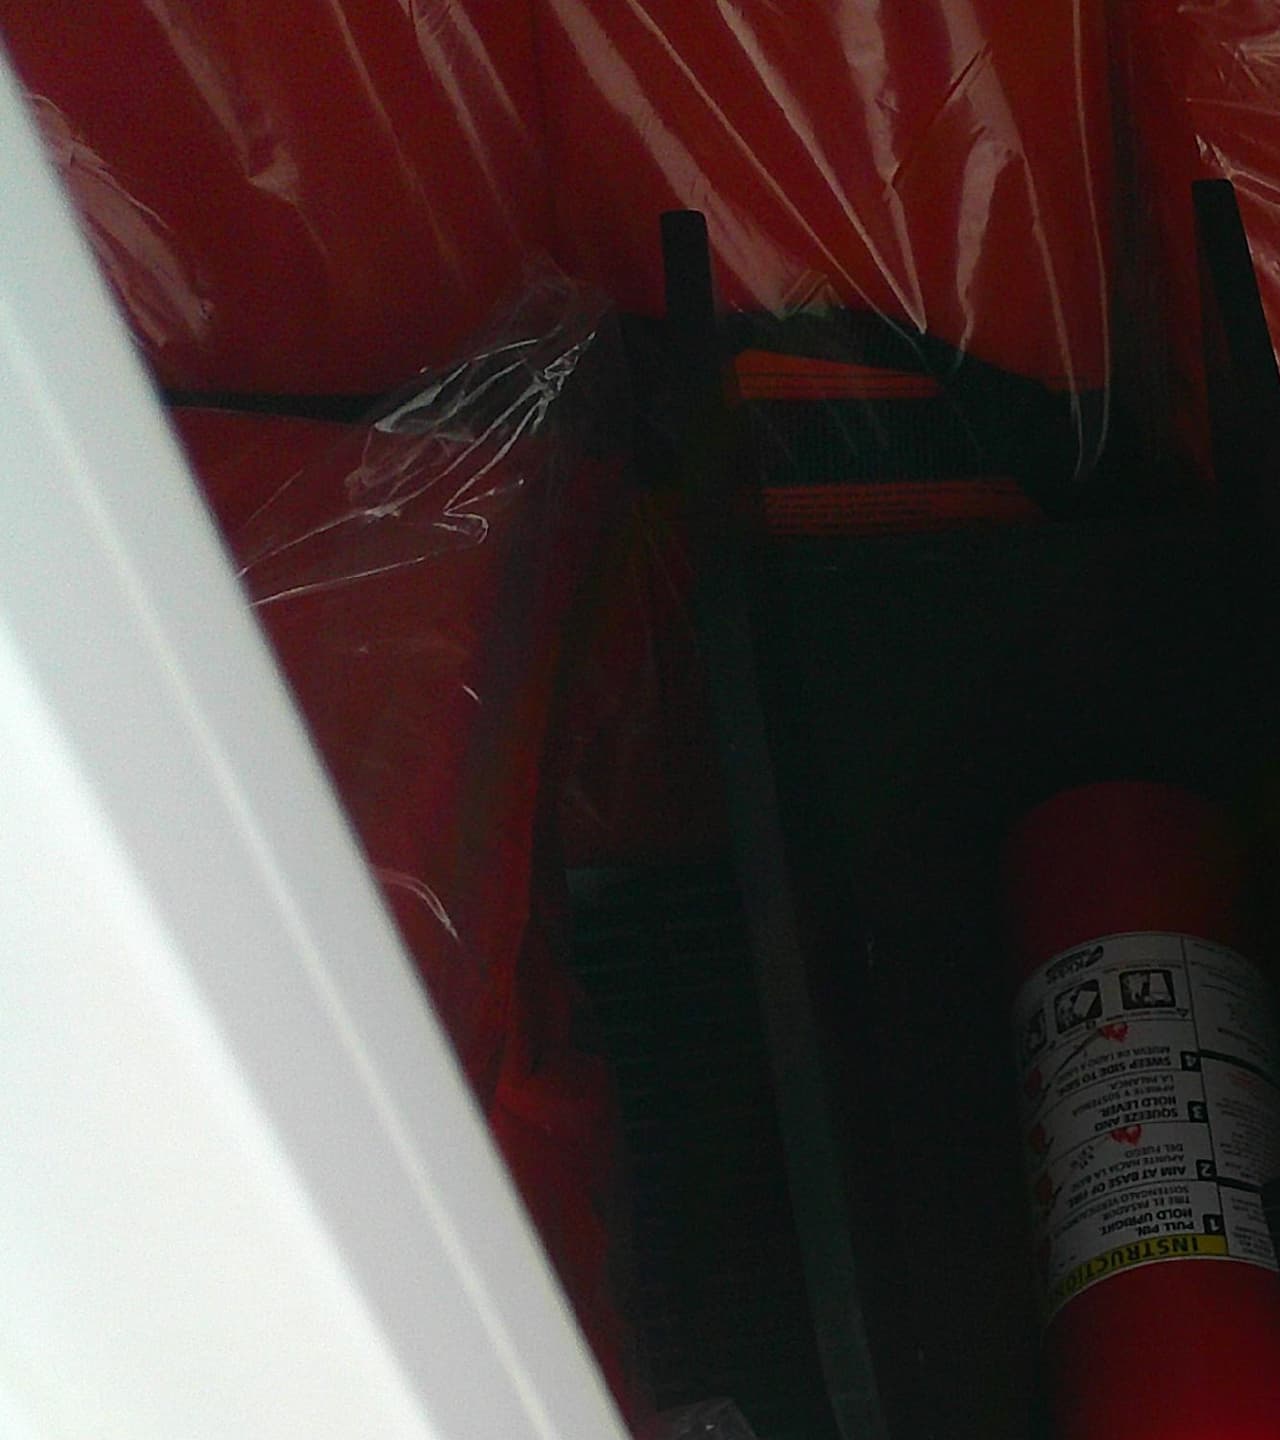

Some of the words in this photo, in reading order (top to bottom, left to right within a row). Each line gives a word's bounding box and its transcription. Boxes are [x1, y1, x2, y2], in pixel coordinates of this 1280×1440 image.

[1130, 1056, 1171, 1069] SWEEP
[1141, 1096, 1177, 1108] HOLD
[1123, 1108, 1179, 1123] SQUEEZE
[1094, 1116, 1121, 1132] AND
[1142, 1167, 1158, 1179] AT
[1160, 1166, 1187, 1177] AIM
[1110, 1170, 1140, 1187] BASE
[1092, 1181, 1107, 1195] OF
[1156, 1208, 1193, 1220] HOLD
[1164, 1220, 1195, 1232] PULL
